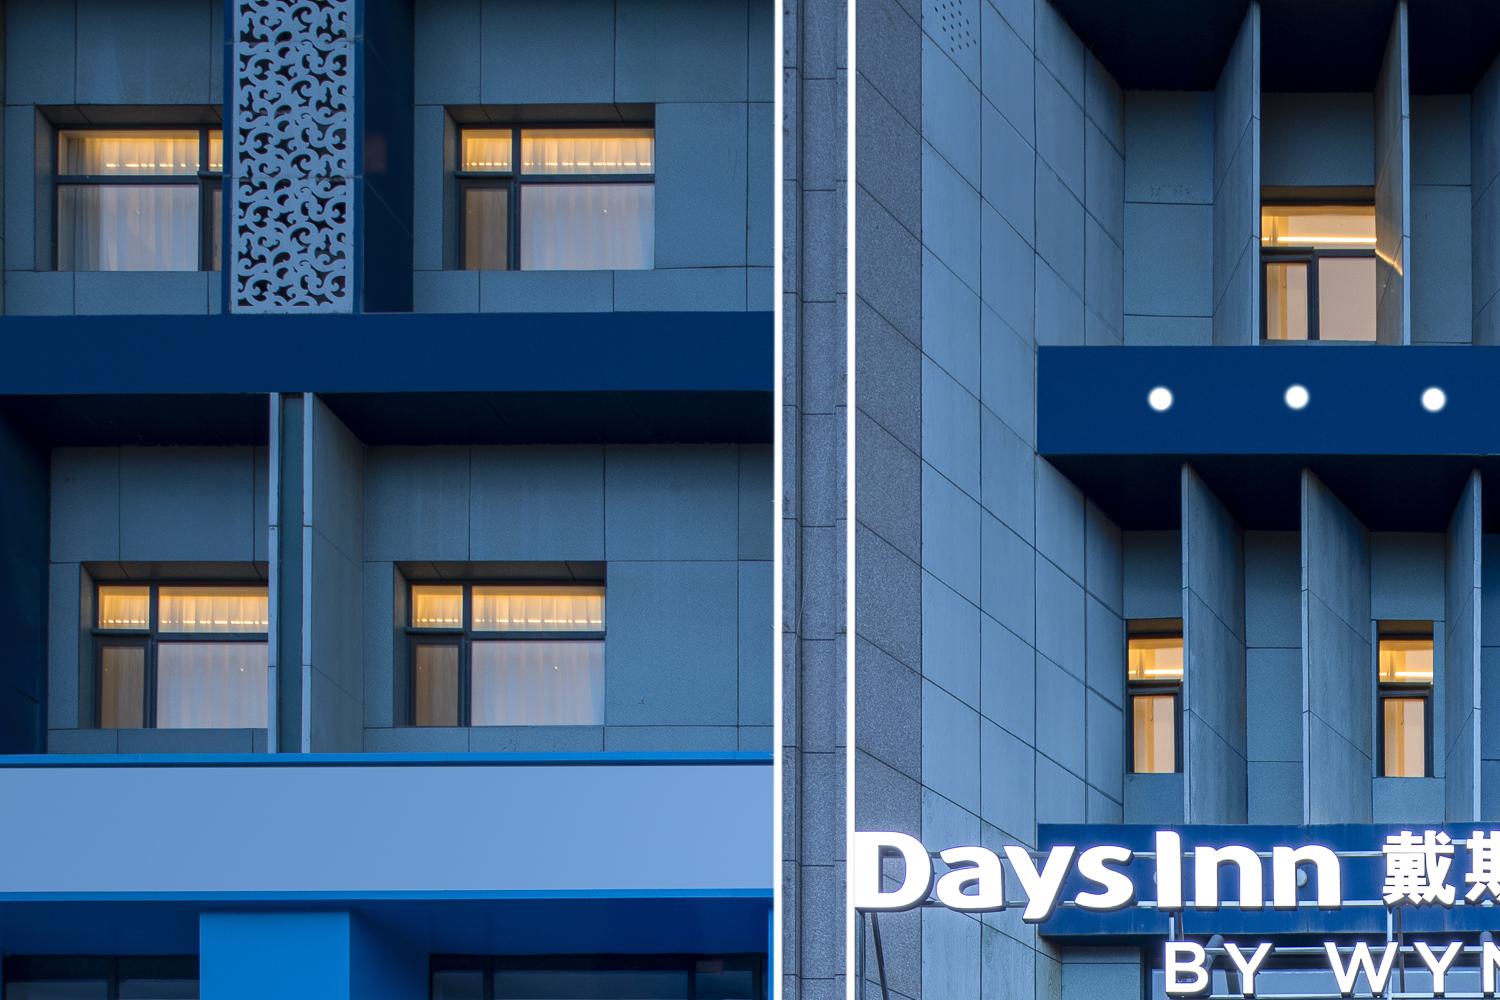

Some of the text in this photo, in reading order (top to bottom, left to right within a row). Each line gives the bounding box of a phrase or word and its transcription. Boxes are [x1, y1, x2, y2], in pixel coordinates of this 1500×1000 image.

[854, 831, 1342, 922] Days Inn
[1164, 941, 1273, 995] BY
